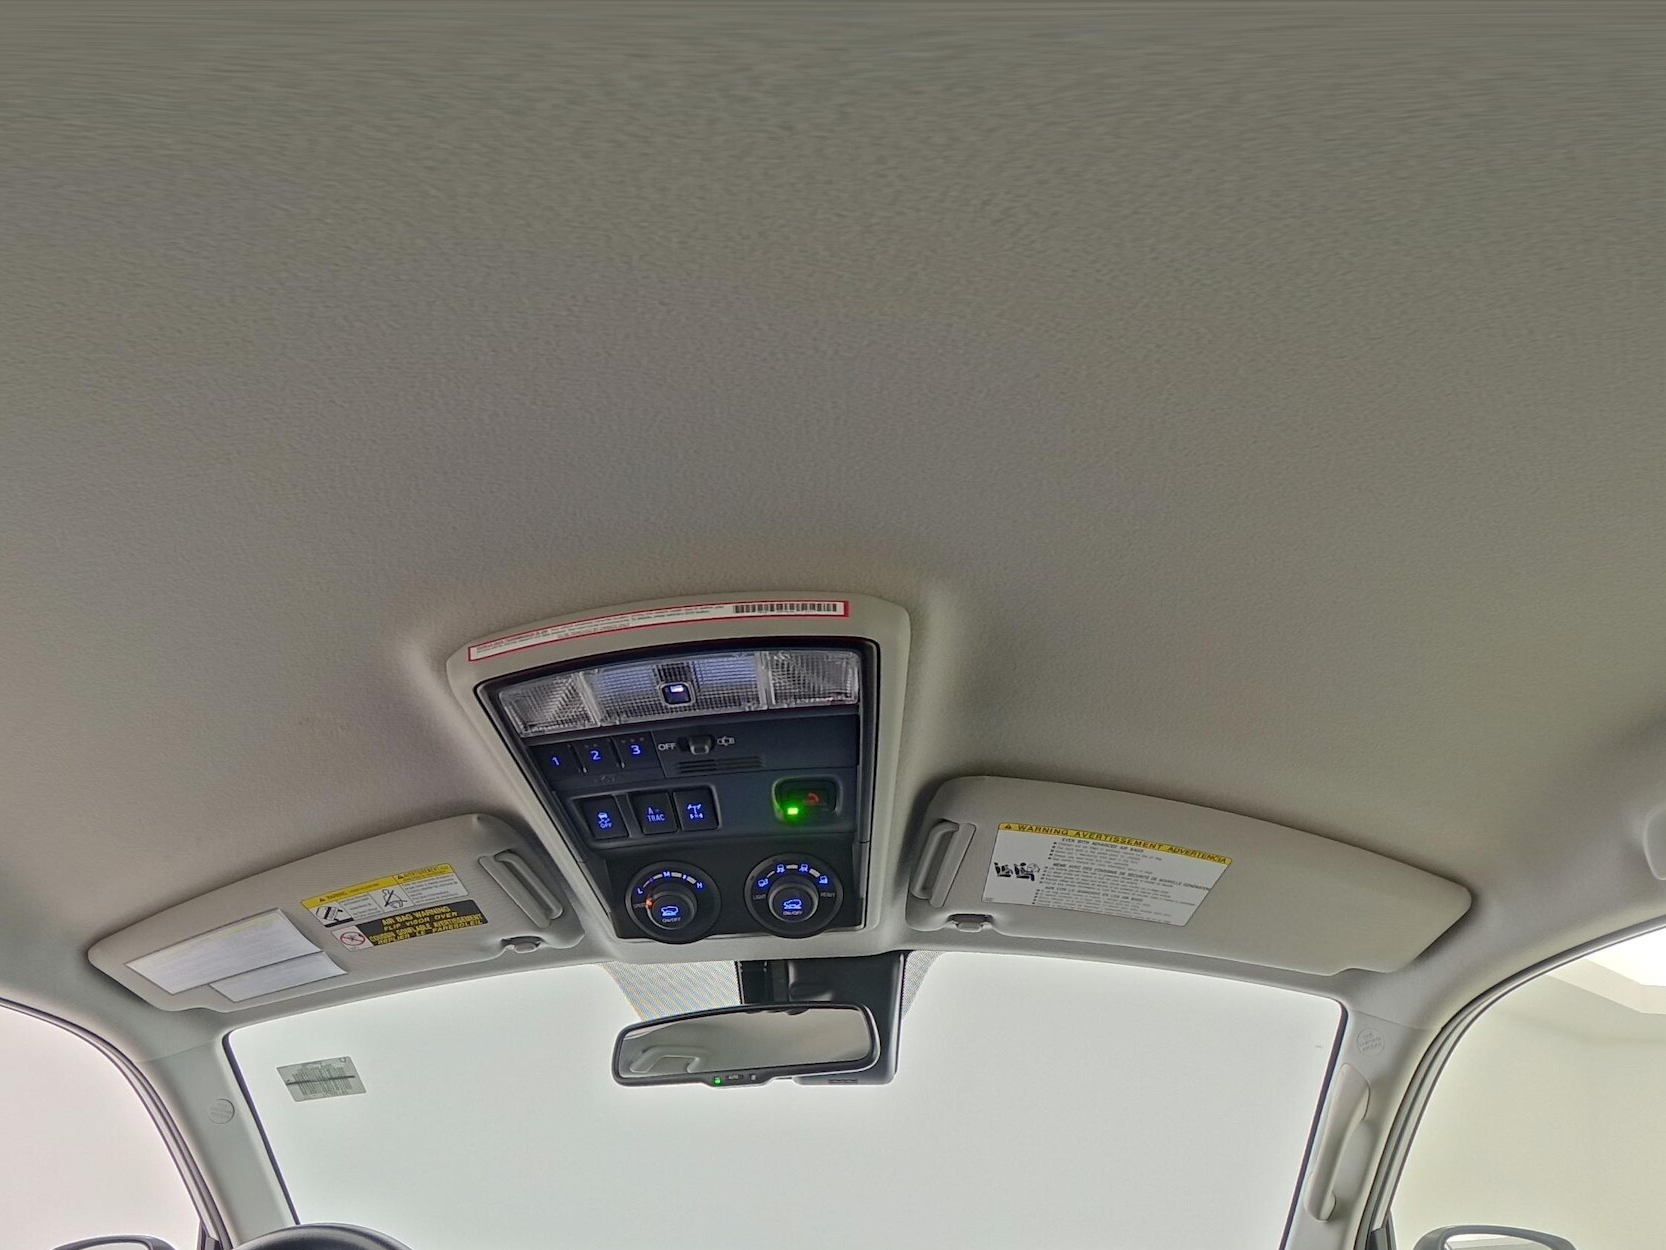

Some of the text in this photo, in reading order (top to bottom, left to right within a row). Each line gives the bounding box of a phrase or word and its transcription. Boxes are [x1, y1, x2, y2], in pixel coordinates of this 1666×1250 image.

[630, 745, 641, 755] 3
[658, 742, 676, 751] OFF
[590, 750, 601, 760] 2
[552, 756, 561, 766] 1
[647, 813, 665, 822] TRAC
[1017, 824, 1069, 835] WARNING
[1074, 831, 1162, 850] AVERTISSEMENT
[1167, 846, 1227, 863] ADVERTENCIA
[637, 887, 643, 895] L
[382, 906, 451, 926] AIR BAG WARNING
[384, 911, 458, 931] FLIP VISOR OVER
